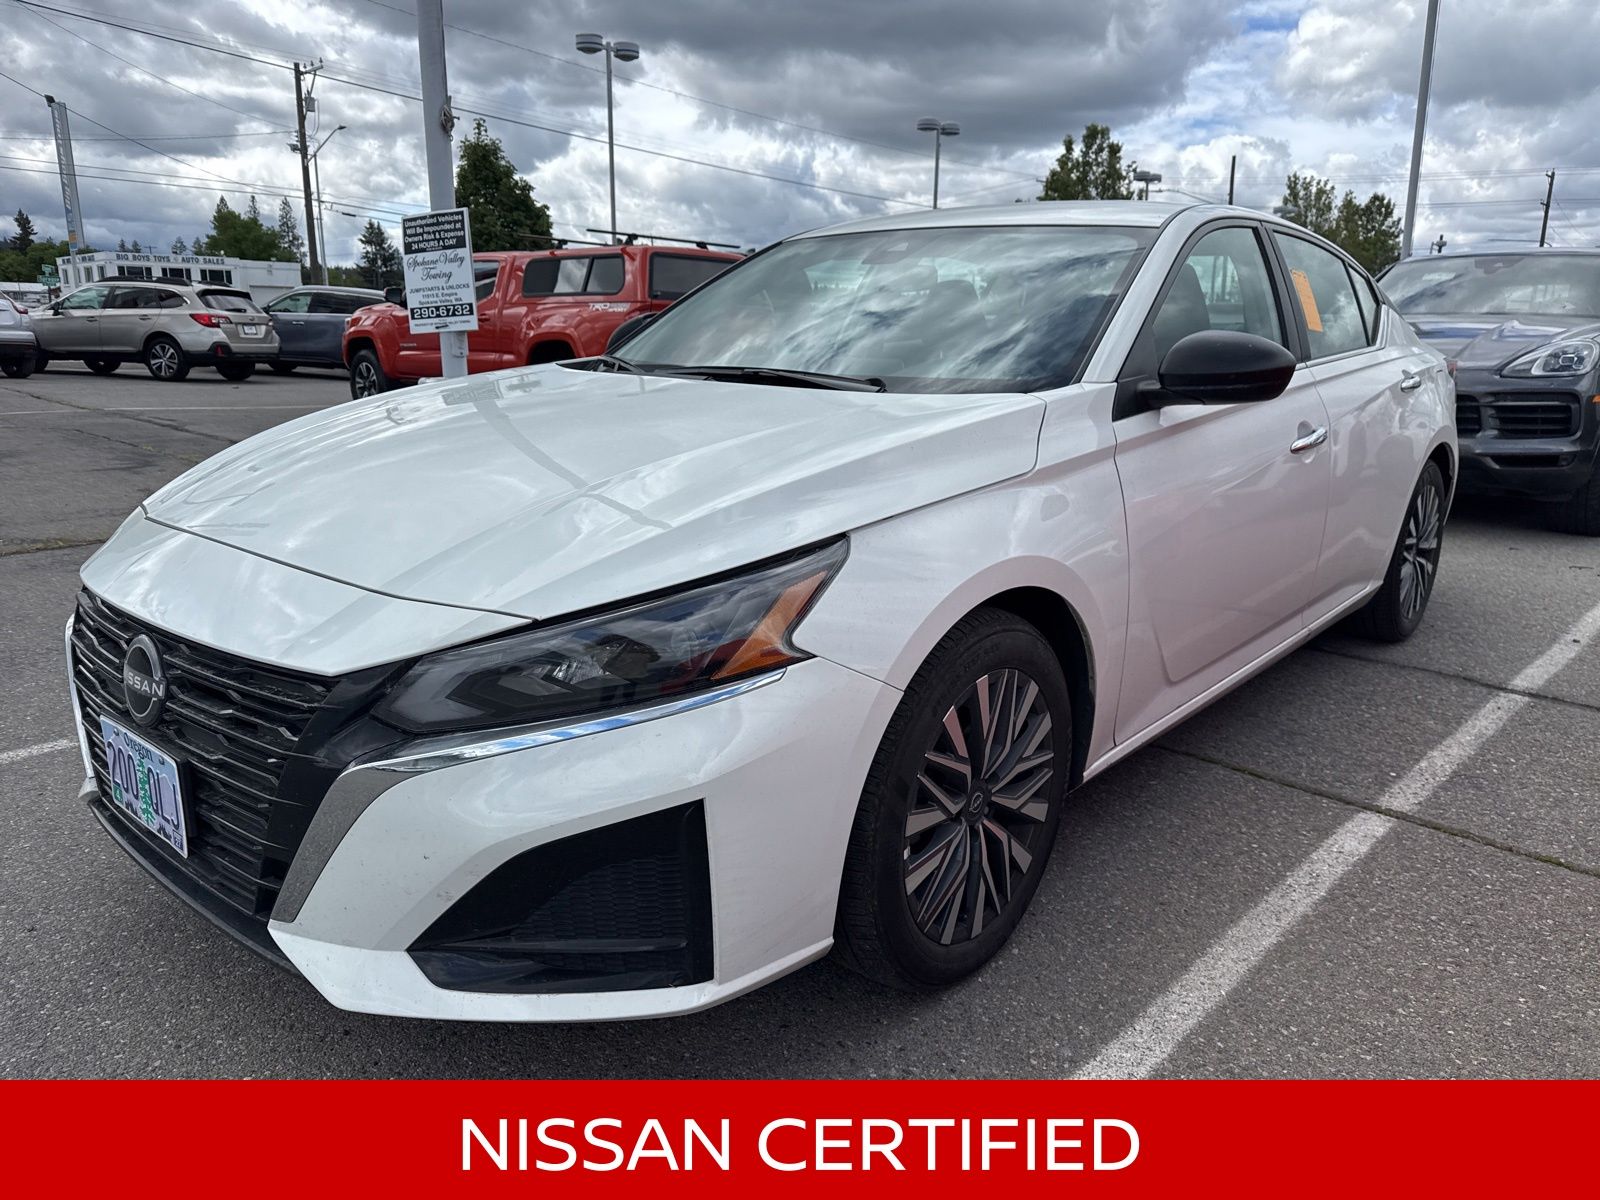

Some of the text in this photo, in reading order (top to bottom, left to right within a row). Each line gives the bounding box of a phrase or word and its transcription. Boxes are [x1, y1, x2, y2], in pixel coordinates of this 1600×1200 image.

[438, 213, 462, 223] Vehicles
[406, 227, 416, 235] Will
[416, 226, 423, 234] Be
[424, 222, 454, 233] Impounded
[404, 230, 465, 244] Owners Risk & Expense
[411, 242, 418, 250] 24
[419, 240, 438, 249] HOURS
[445, 237, 457, 246] DAY
[115, 253, 225, 265] BIG BOYS TOYS AUTO SALES
[407, 251, 465, 272] Spokane Valley
[421, 266, 453, 284] Towing
[409, 286, 440, 294] JUMPSTARTS
[445, 283, 470, 291] UNLOCKS
[413, 304, 470, 319] 290-6732
[123, 732, 154, 763] Oregon
[107, 741, 180, 831] 200 QLJ
